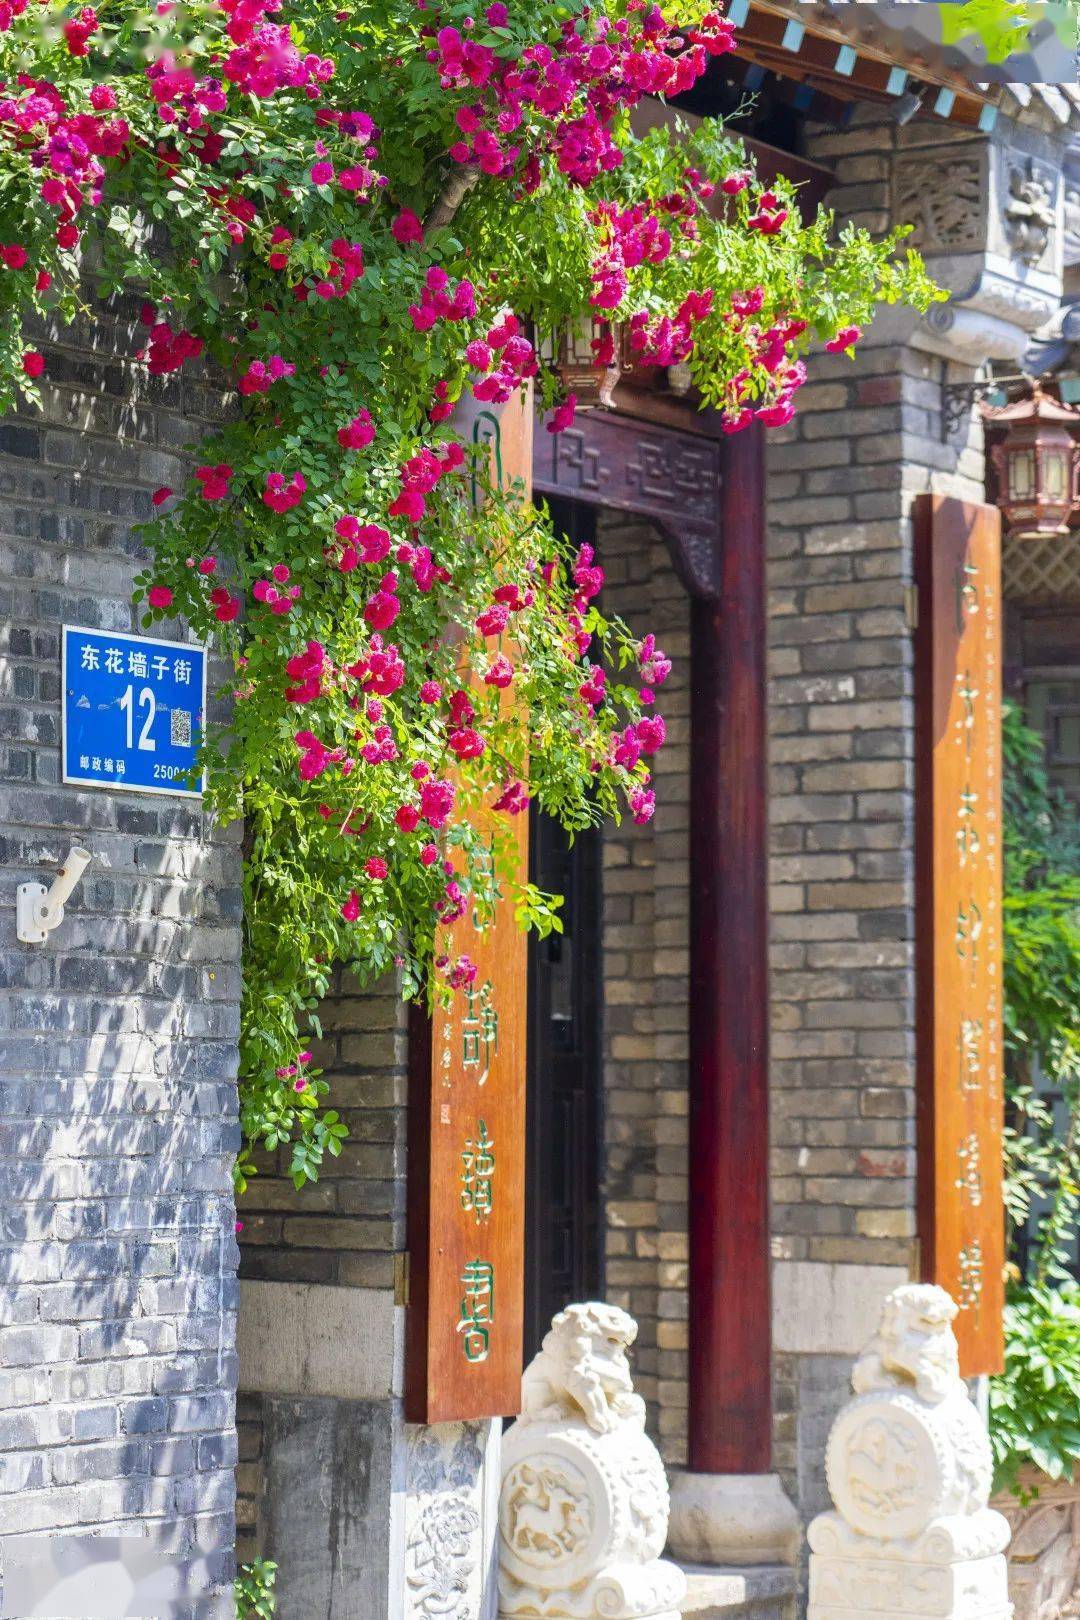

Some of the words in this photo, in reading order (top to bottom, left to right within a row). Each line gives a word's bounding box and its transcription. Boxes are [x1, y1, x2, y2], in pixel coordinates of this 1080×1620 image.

[80, 644, 192, 685] 东花墙子街
[120, 684, 156, 752] 12
[79, 754, 126, 775] 邮政编码
